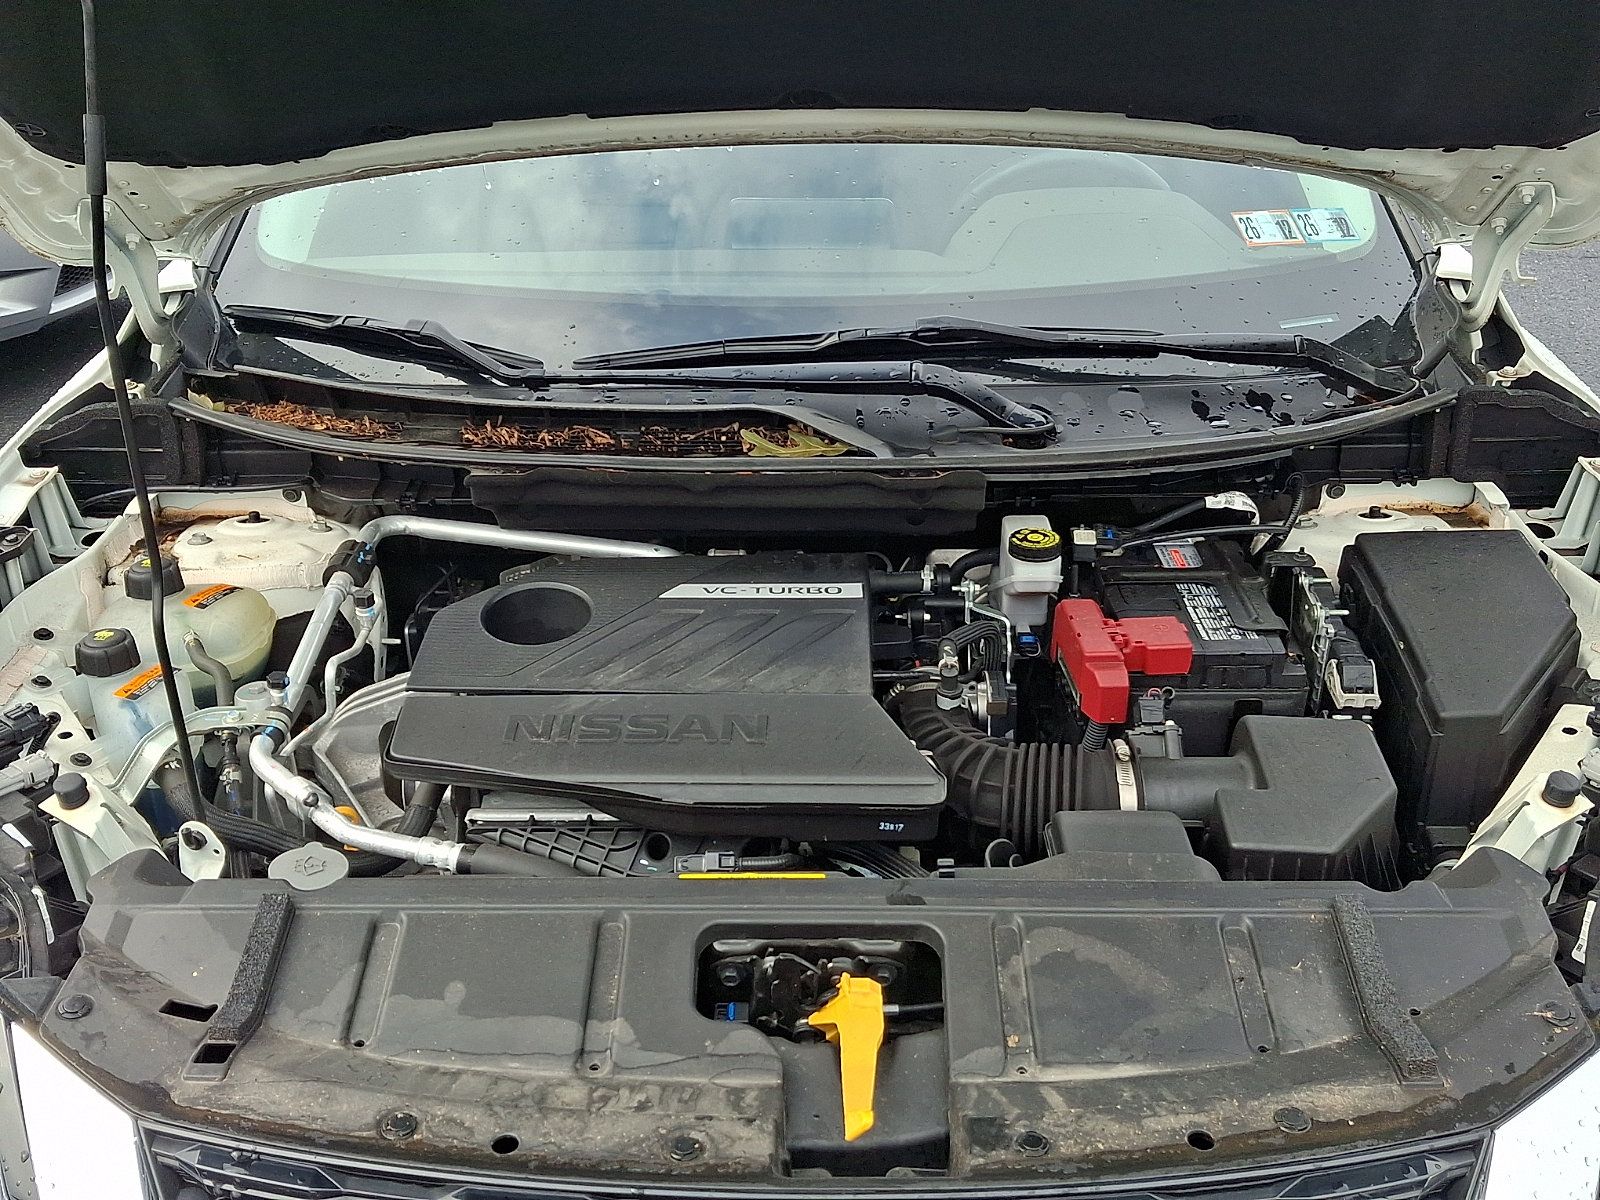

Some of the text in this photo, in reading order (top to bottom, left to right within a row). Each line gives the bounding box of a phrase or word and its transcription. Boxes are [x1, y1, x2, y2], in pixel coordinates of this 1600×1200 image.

[1238, 217, 1299, 239] 26 12
[1296, 214, 1319, 236] 26
[702, 586, 843, 595] VC-TURBO
[503, 714, 769, 746] NISSAN
